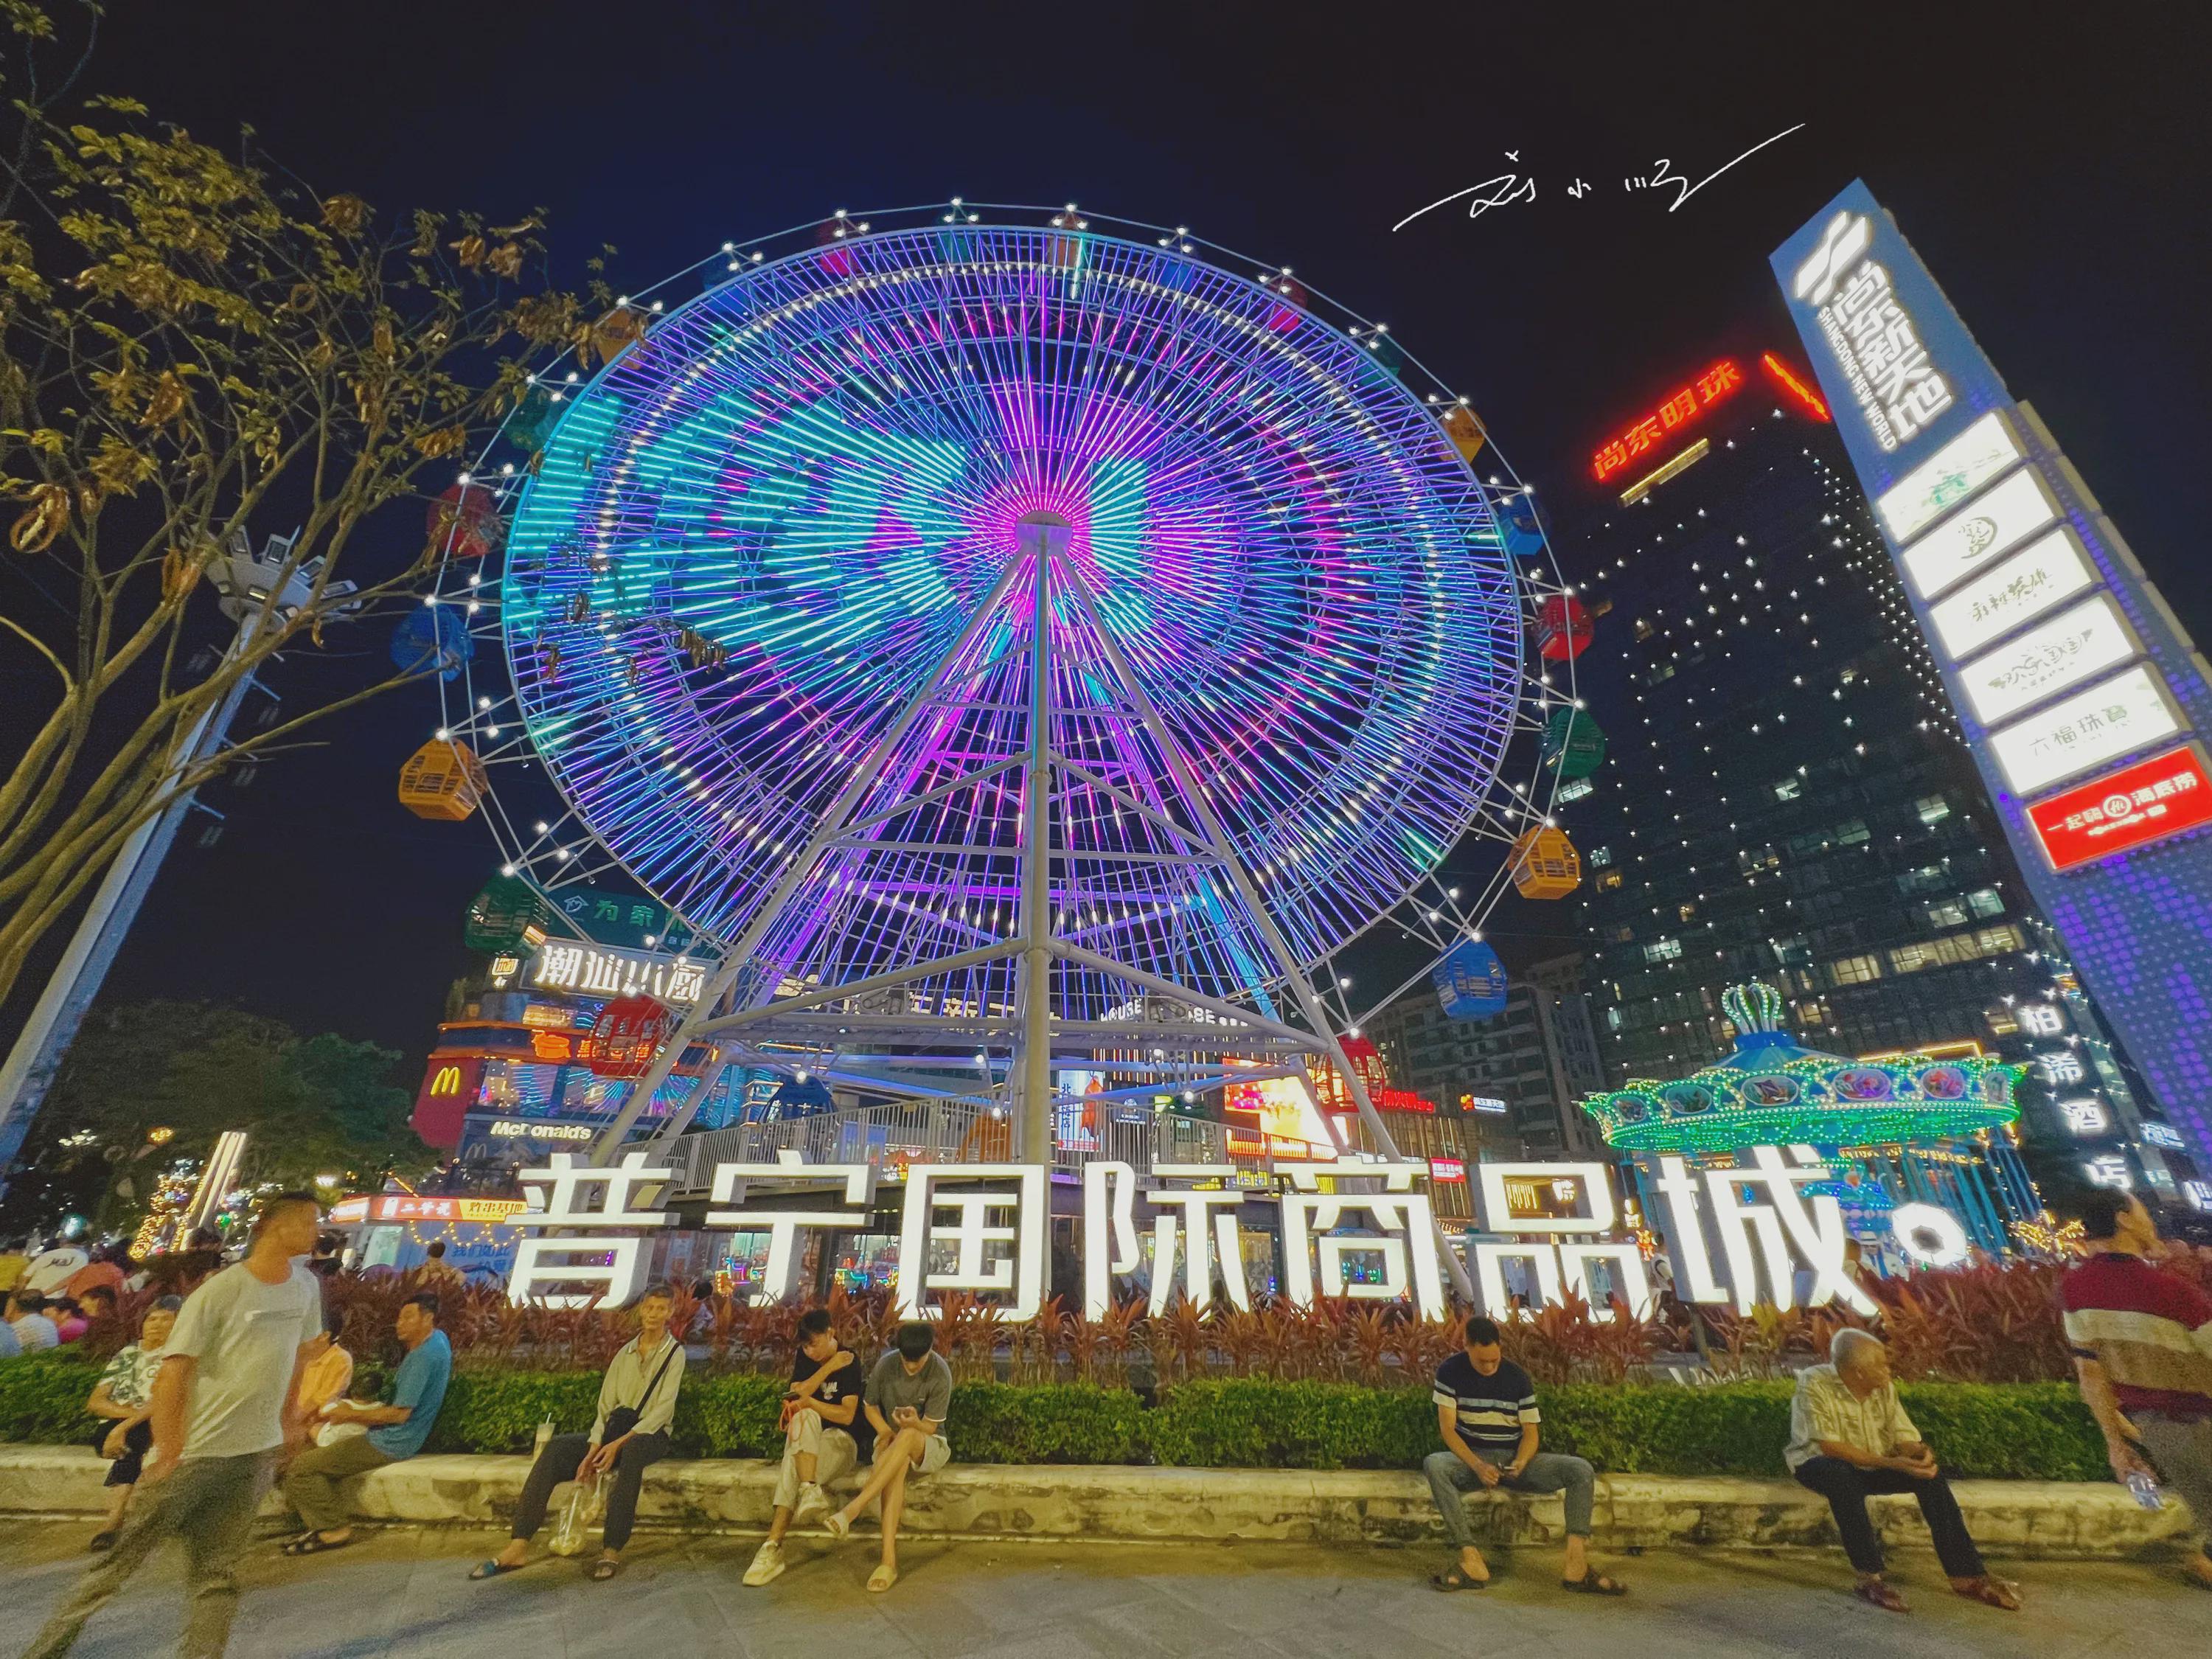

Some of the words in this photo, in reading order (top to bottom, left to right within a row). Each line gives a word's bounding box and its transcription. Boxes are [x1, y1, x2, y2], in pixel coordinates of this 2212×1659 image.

[1594, 361, 1740, 479] 尚东明珠
[1816, 305, 1860, 377] SHANGDONG
[1851, 375, 1873, 404] NEW
[1865, 402, 1896, 449] WORLD
[490, 1121, 591, 1140] McDonald's
